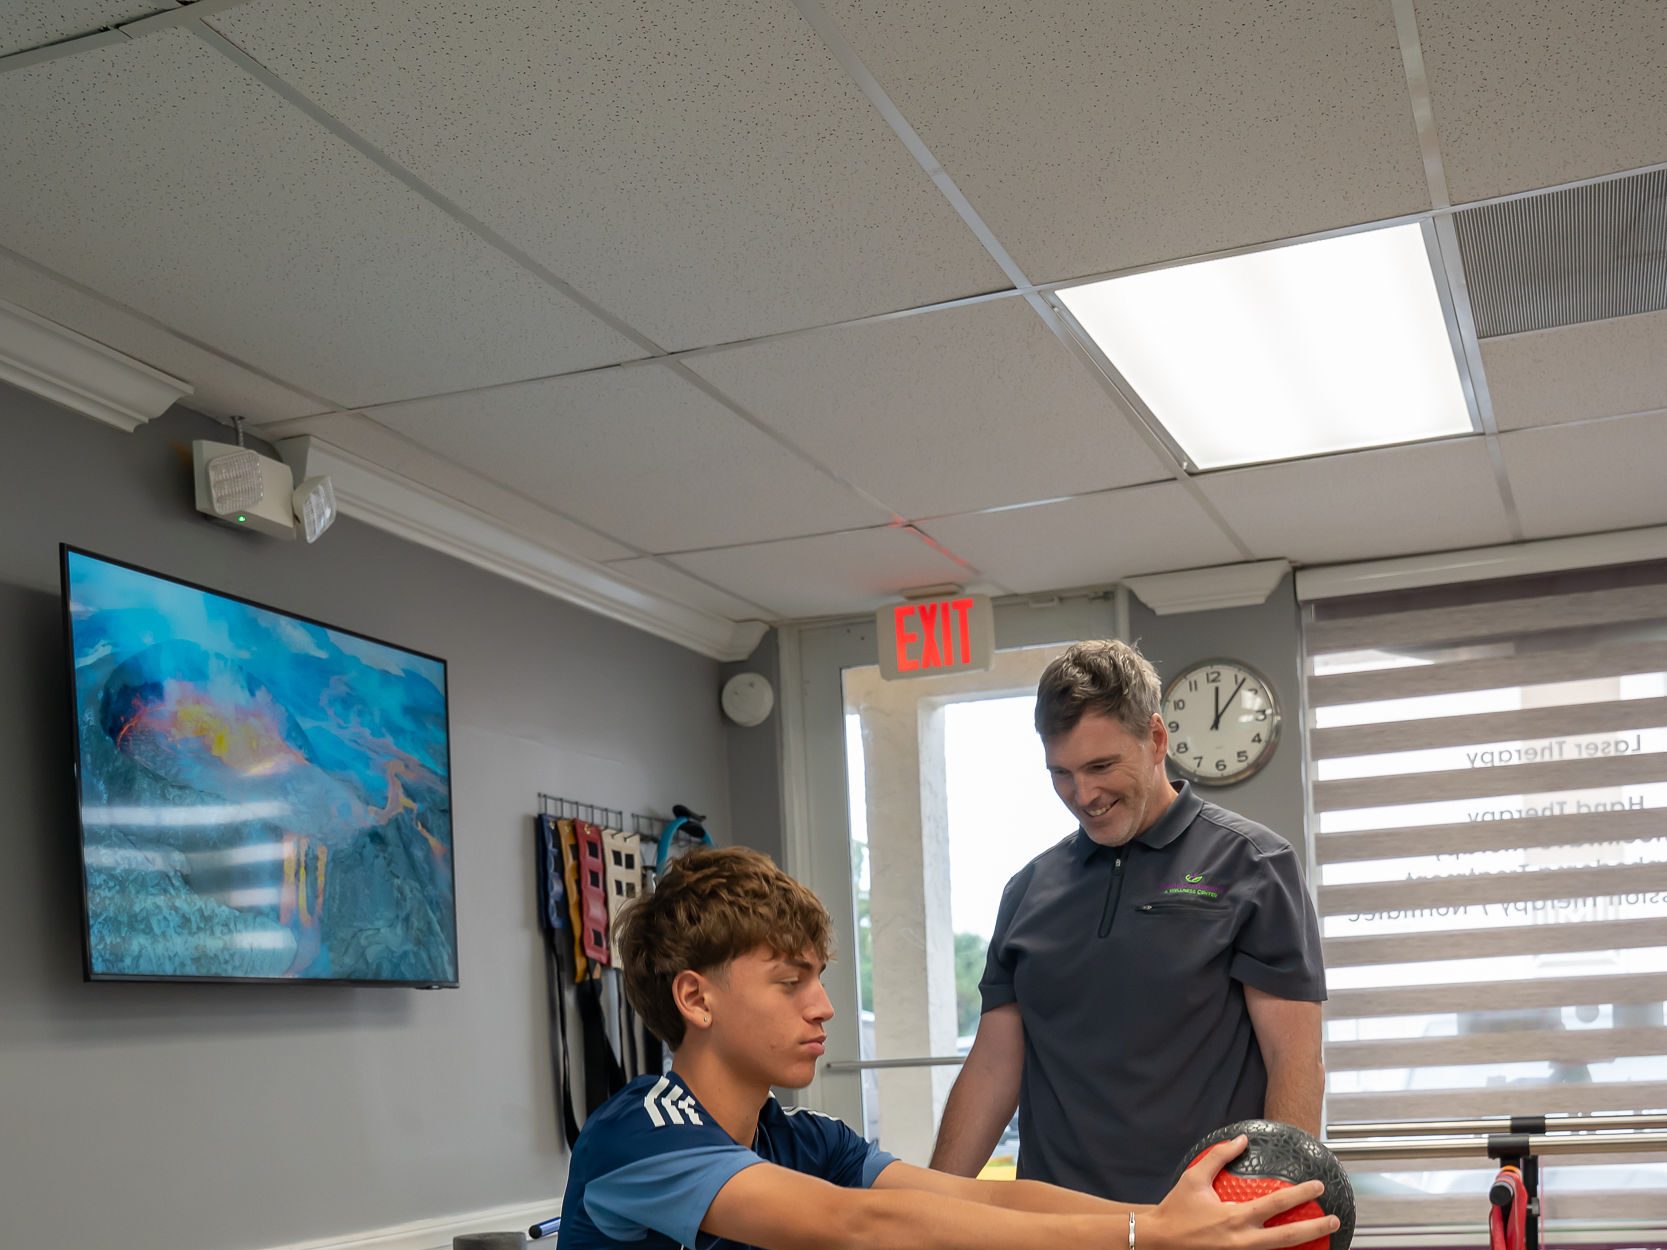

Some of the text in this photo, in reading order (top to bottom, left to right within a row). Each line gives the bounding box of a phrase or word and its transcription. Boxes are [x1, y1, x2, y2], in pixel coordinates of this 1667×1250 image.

[894, 598, 973, 672] EXIT
[1206, 671, 1221, 683] 12
[1233, 674, 1238, 685] 1
[1189, 680, 1198, 692] 11
[1173, 699, 1185, 710] 10
[1168, 721, 1179, 732] 9
[1251, 733, 1262, 744] 4
[1176, 742, 1188, 753] 8
[1193, 756, 1203, 768] 7
[1237, 751, 1248, 762] 5
[1215, 759, 1227, 771] 6
